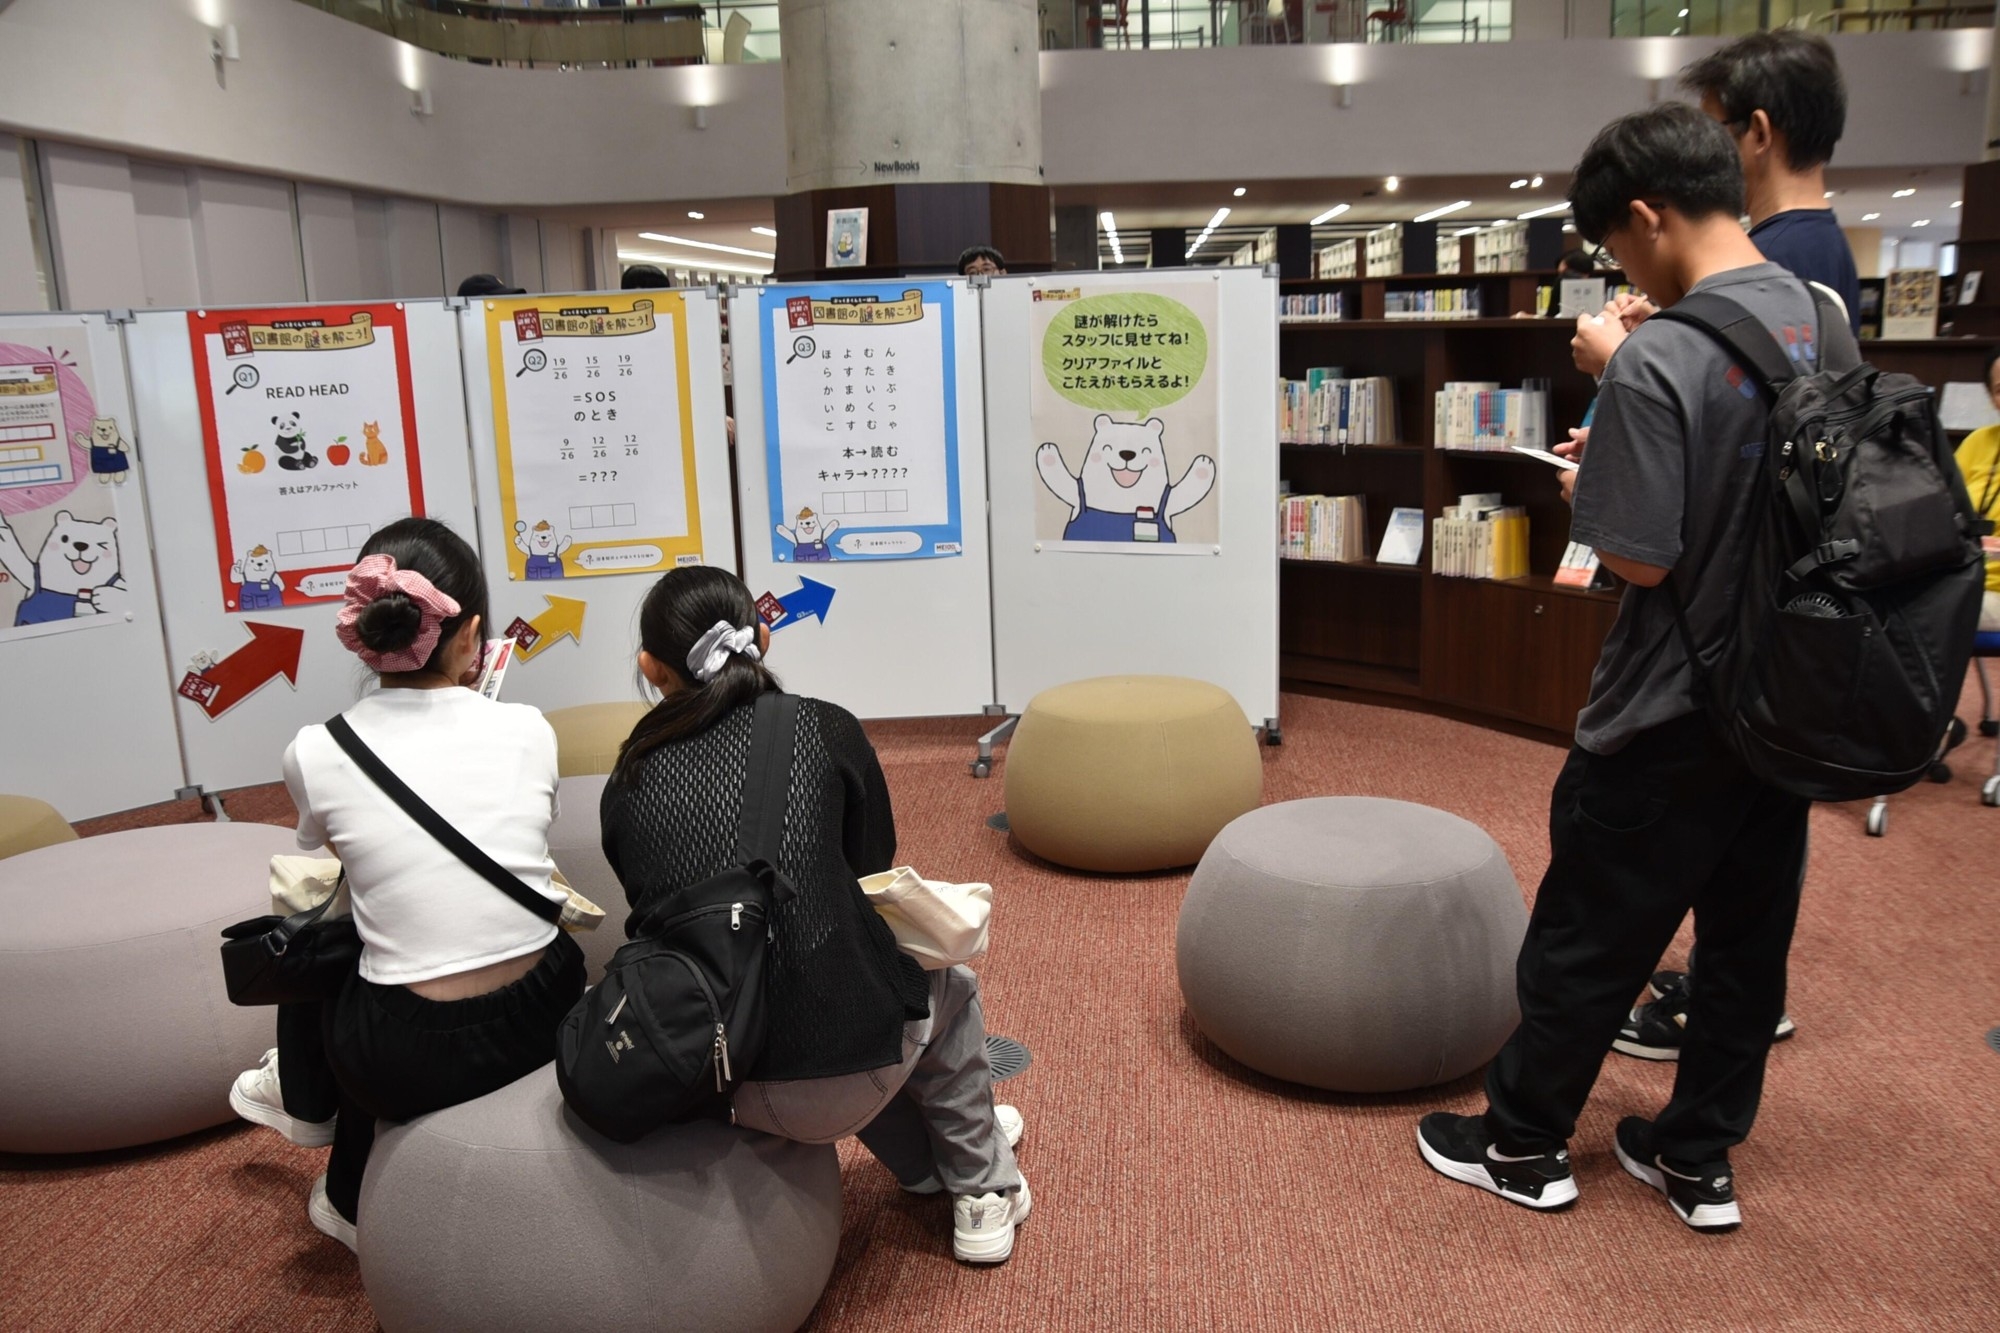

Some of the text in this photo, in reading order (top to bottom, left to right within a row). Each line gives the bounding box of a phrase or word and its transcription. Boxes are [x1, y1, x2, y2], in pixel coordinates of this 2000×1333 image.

[813, 304, 917, 323] 図書館の謎を解こう！
[541, 314, 649, 335] 図書館の謎を解こう！
[1074, 314, 1159, 329] 謎が解けたら
[252, 327, 368, 349] 図書館の謎を解こう！
[1062, 332, 1189, 347] スタッフに見せてね！
[797, 342, 812, 353] Q3
[528, 355, 543, 366] Q2
[1062, 356, 1162, 371] クリアファイルと
[238, 371, 254, 383] Q1
[1062, 375, 1189, 389] こたえがもらえるよ！
[266, 383, 349, 399] READ HEAD
[574, 408, 617, 422] のとき
[279, 481, 359, 496] 答えはアルファベット
